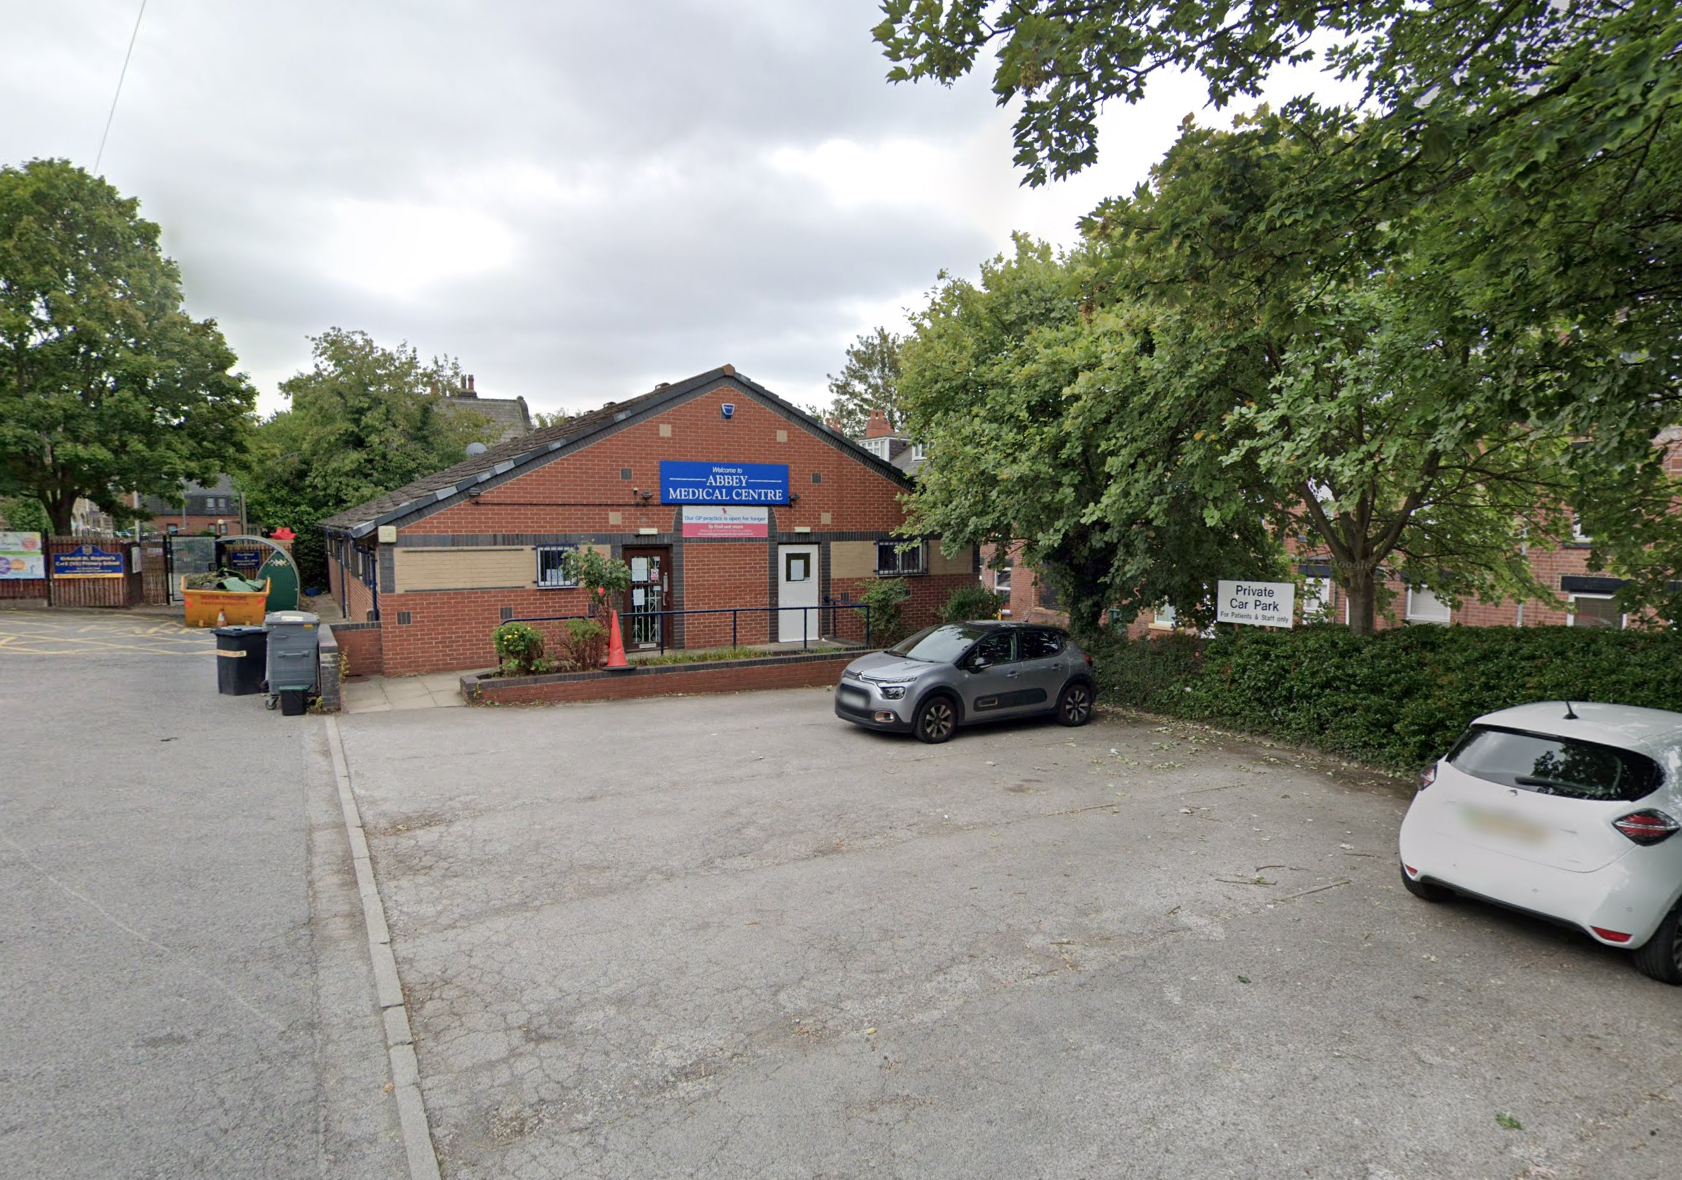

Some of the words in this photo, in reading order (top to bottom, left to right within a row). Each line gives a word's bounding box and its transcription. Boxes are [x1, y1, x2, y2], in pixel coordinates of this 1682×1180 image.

[706, 475, 748, 486] ABBEY
[669, 488, 730, 500] MEDICAL
[732, 489, 783, 500] CENTRE
[1236, 585, 1274, 597] Private
[1230, 598, 1248, 609] Car
[1254, 600, 1279, 612] Park
